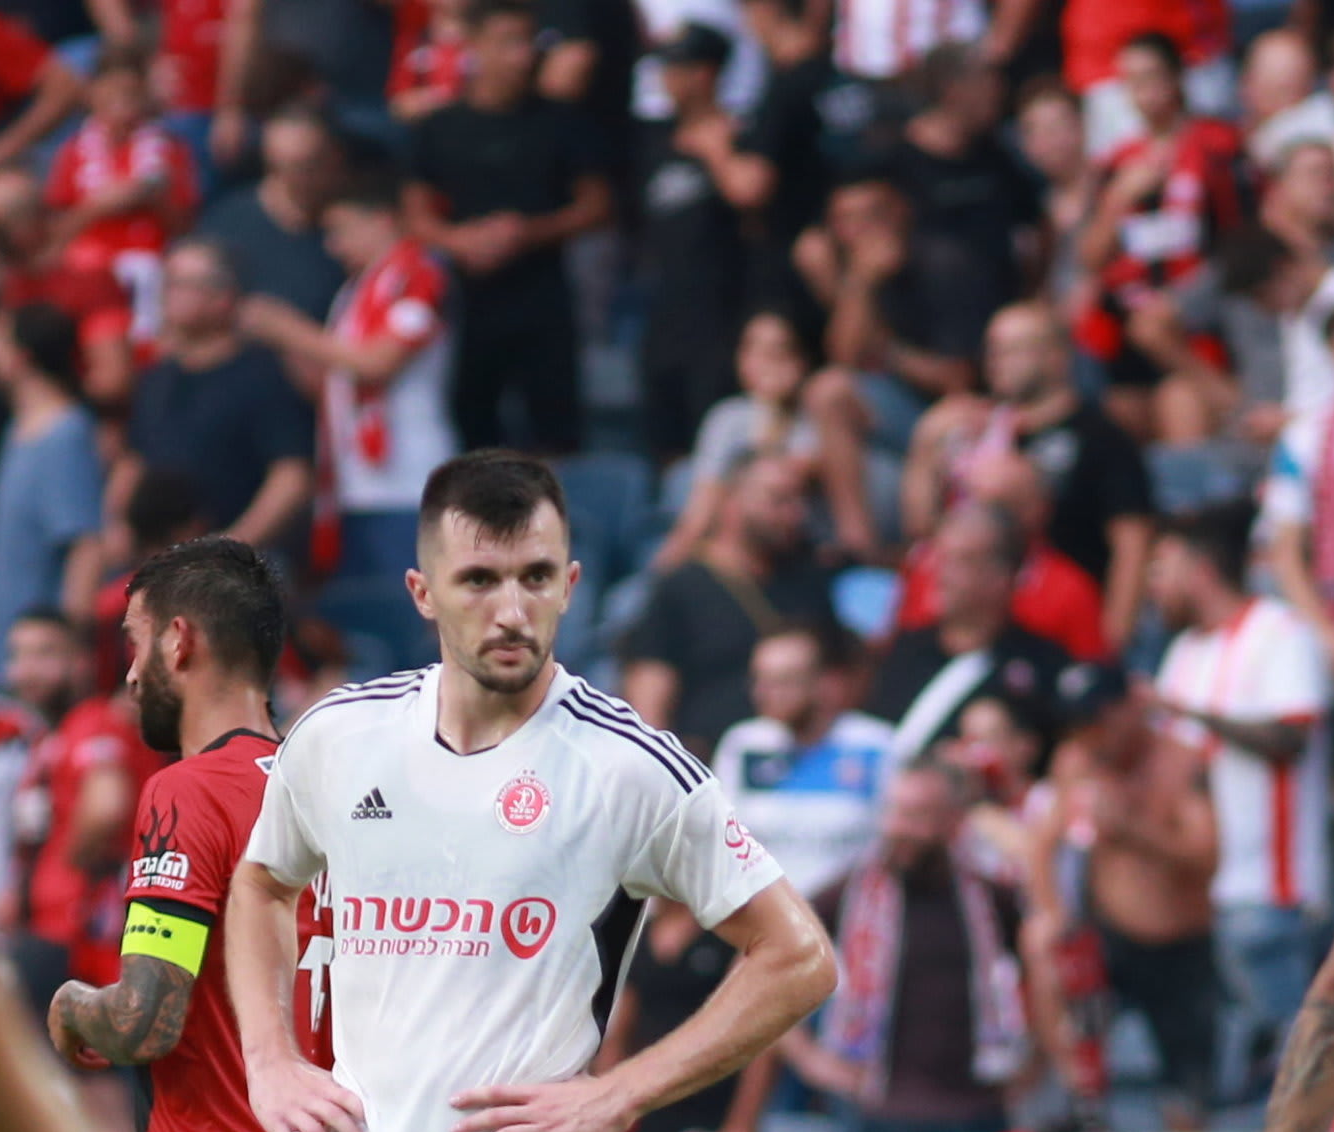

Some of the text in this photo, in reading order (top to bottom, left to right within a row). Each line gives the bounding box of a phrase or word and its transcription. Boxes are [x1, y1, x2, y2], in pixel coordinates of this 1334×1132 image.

[350, 806, 393, 820] adidas
[341, 896, 494, 933] הכשרה
[380, 936, 437, 956] לביטוח
[440, 939, 490, 957] חברה
